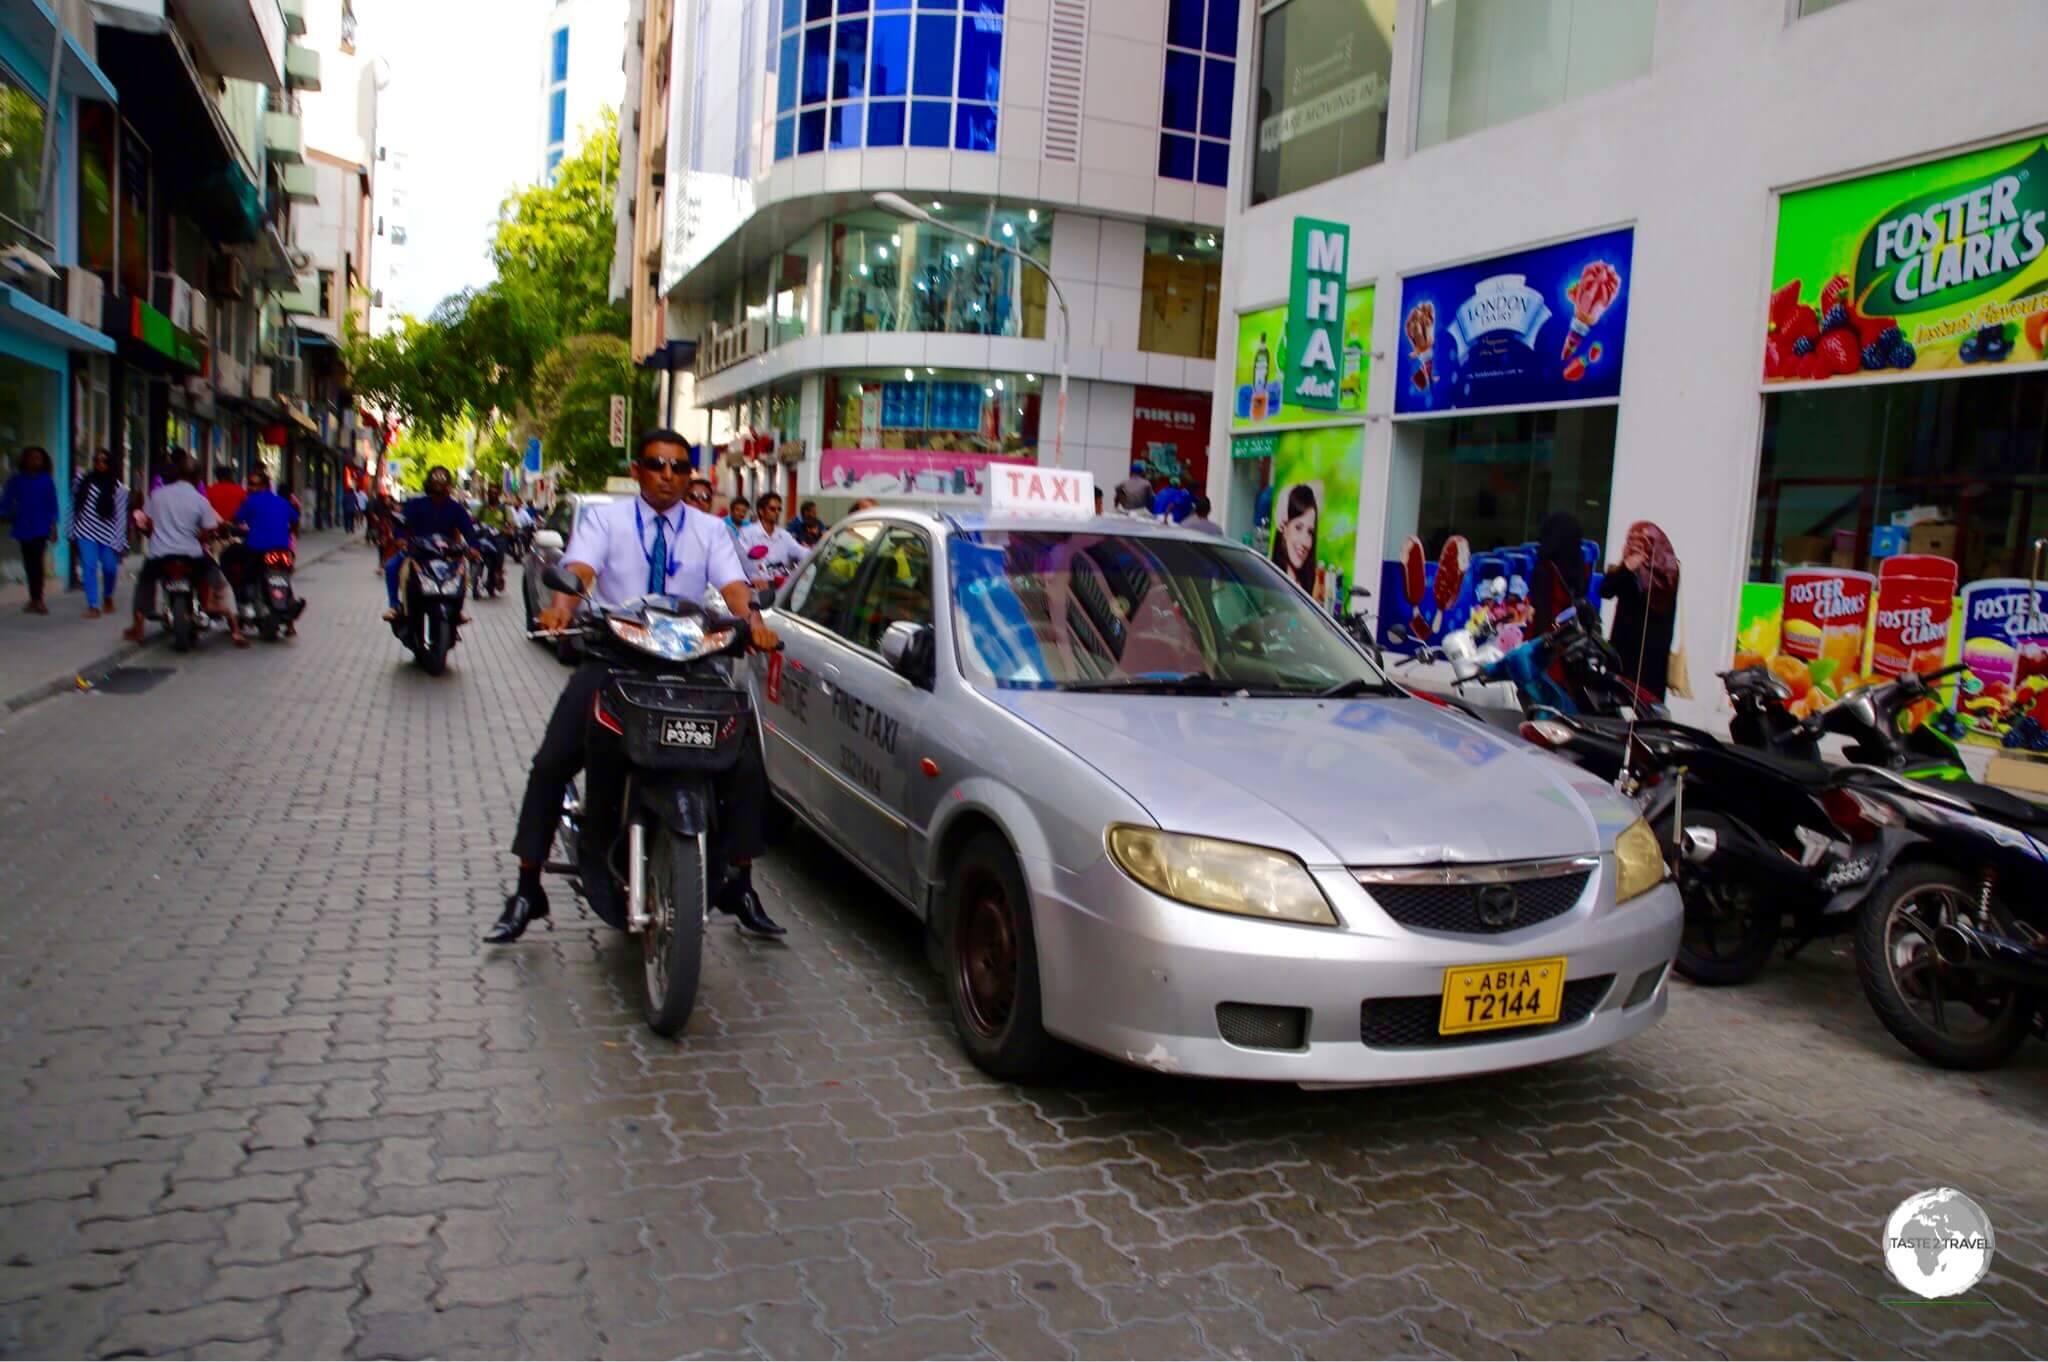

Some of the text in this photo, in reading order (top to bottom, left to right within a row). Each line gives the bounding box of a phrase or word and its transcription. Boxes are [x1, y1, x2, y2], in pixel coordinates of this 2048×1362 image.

[1306, 88, 1356, 121] MOVING
[1360, 80, 1375, 101] IN
[1875, 175, 2021, 268] FOSTER
[1894, 209, 2046, 301] CLARK'S
[1467, 294, 1527, 322] LONDON
[1007, 471, 1080, 504] TAXI
[1790, 578, 1844, 603] FOSTER
[1973, 591, 2042, 621] FOSTER
[1877, 607, 1932, 629] FOSTER
[667, 729, 711, 745] P3796
[864, 703, 899, 755] TAXI
[1465, 988, 1541, 1022] T2144
